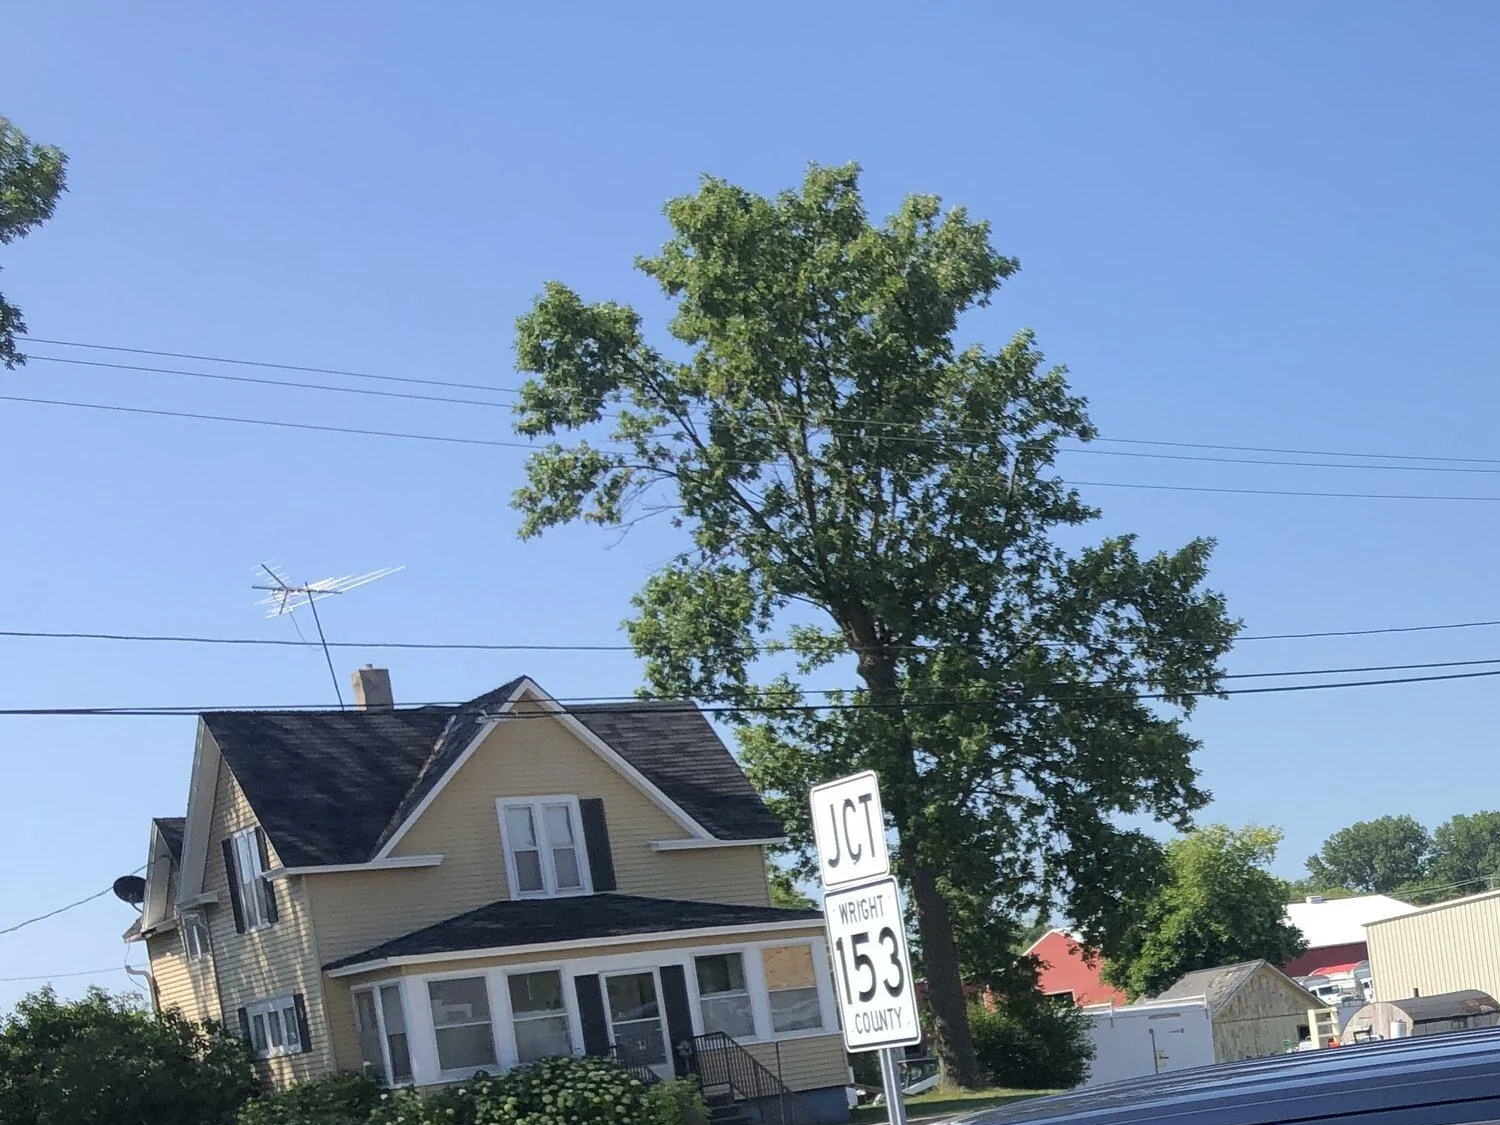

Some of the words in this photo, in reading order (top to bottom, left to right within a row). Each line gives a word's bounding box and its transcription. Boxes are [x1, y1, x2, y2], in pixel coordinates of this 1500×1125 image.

[827, 792, 876, 868] JCT
[838, 894, 885, 925] WRIGHT
[835, 925, 904, 1006] 153
[855, 1006, 903, 1034] COUNTY
